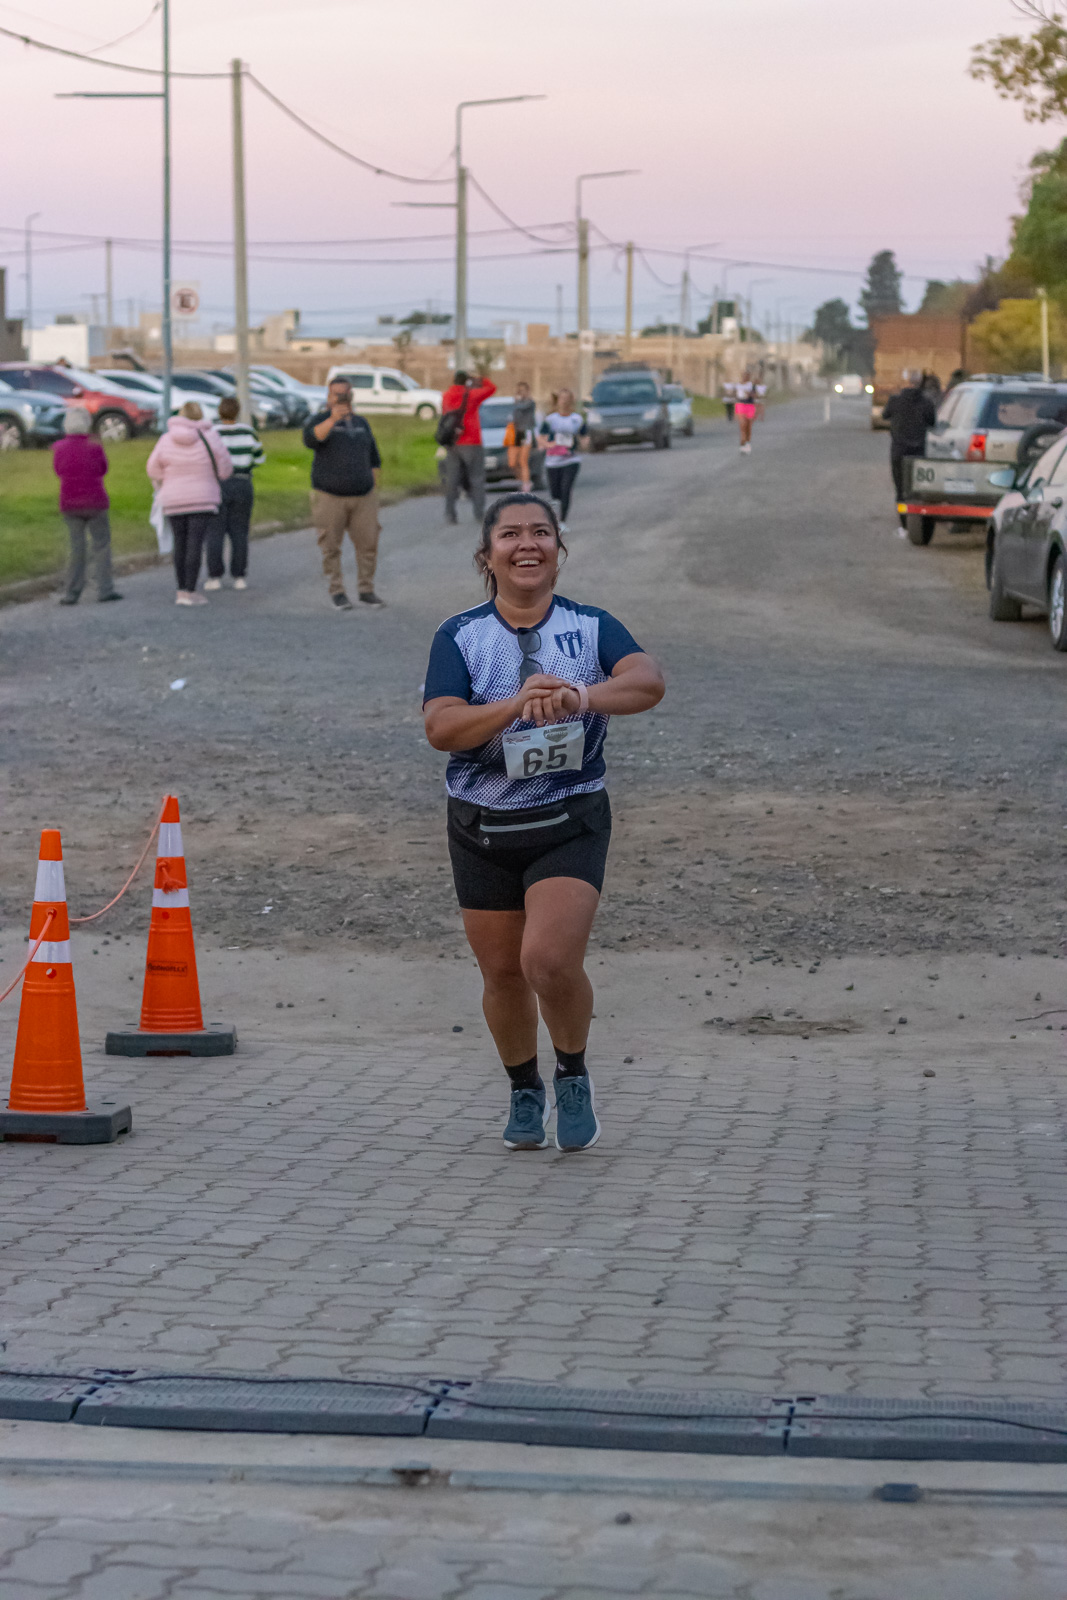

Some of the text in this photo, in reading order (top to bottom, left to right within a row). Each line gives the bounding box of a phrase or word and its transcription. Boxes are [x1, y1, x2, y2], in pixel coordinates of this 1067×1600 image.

[916, 467, 935, 482] 80
[560, 632, 578, 641] SFC
[523, 744, 567, 776] 65
